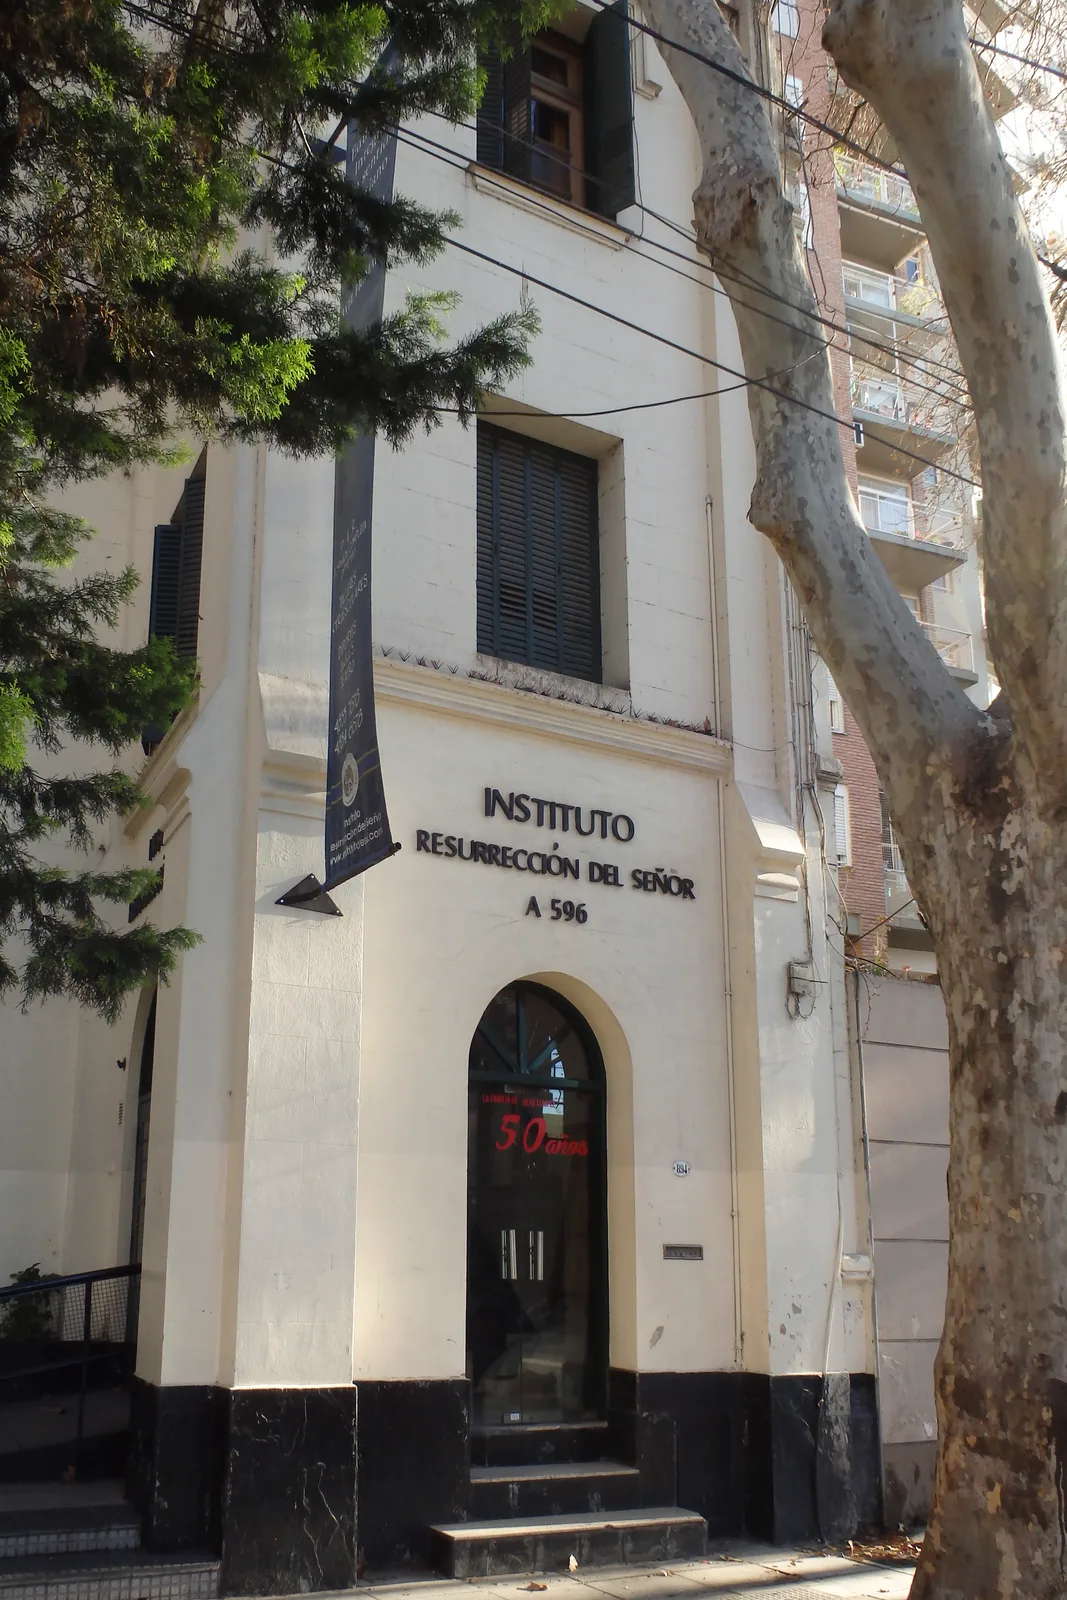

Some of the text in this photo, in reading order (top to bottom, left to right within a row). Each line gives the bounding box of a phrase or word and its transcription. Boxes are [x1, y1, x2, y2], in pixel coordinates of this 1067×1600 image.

[484, 787, 635, 842] INSTITUTO
[416, 829, 696, 900] RESURRECCIÓN DEL SEÑOR
[525, 896, 588, 924] A 596
[495, 1114, 589, 1156] 50 años
